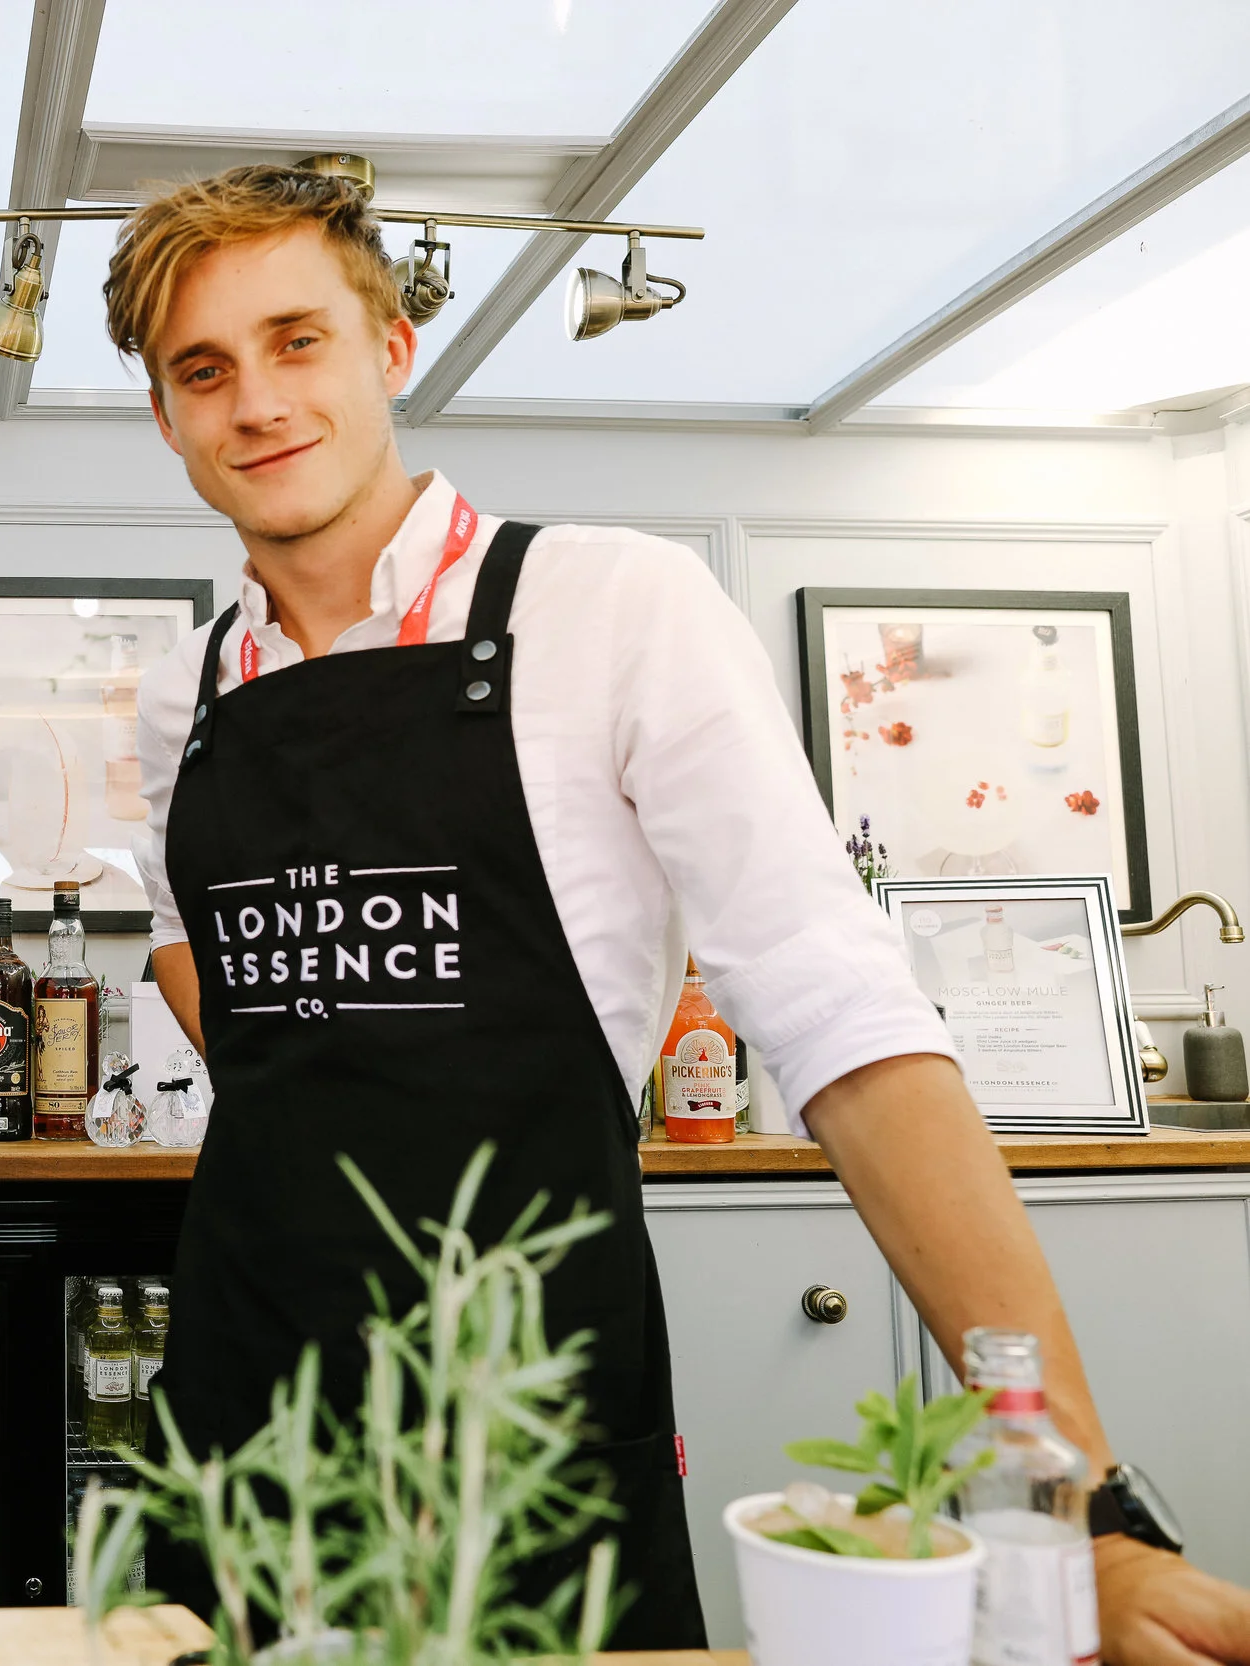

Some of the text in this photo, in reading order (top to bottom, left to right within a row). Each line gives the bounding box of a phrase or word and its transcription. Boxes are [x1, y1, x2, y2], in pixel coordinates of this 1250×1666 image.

[286, 864, 339, 889] THE
[214, 892, 459, 942] LONDON
[220, 943, 461, 986] ESSENCE
[938, 986, 1069, 997] MOSC-LOW MULE
[672, 1065, 732, 1078] PICKERING'S
